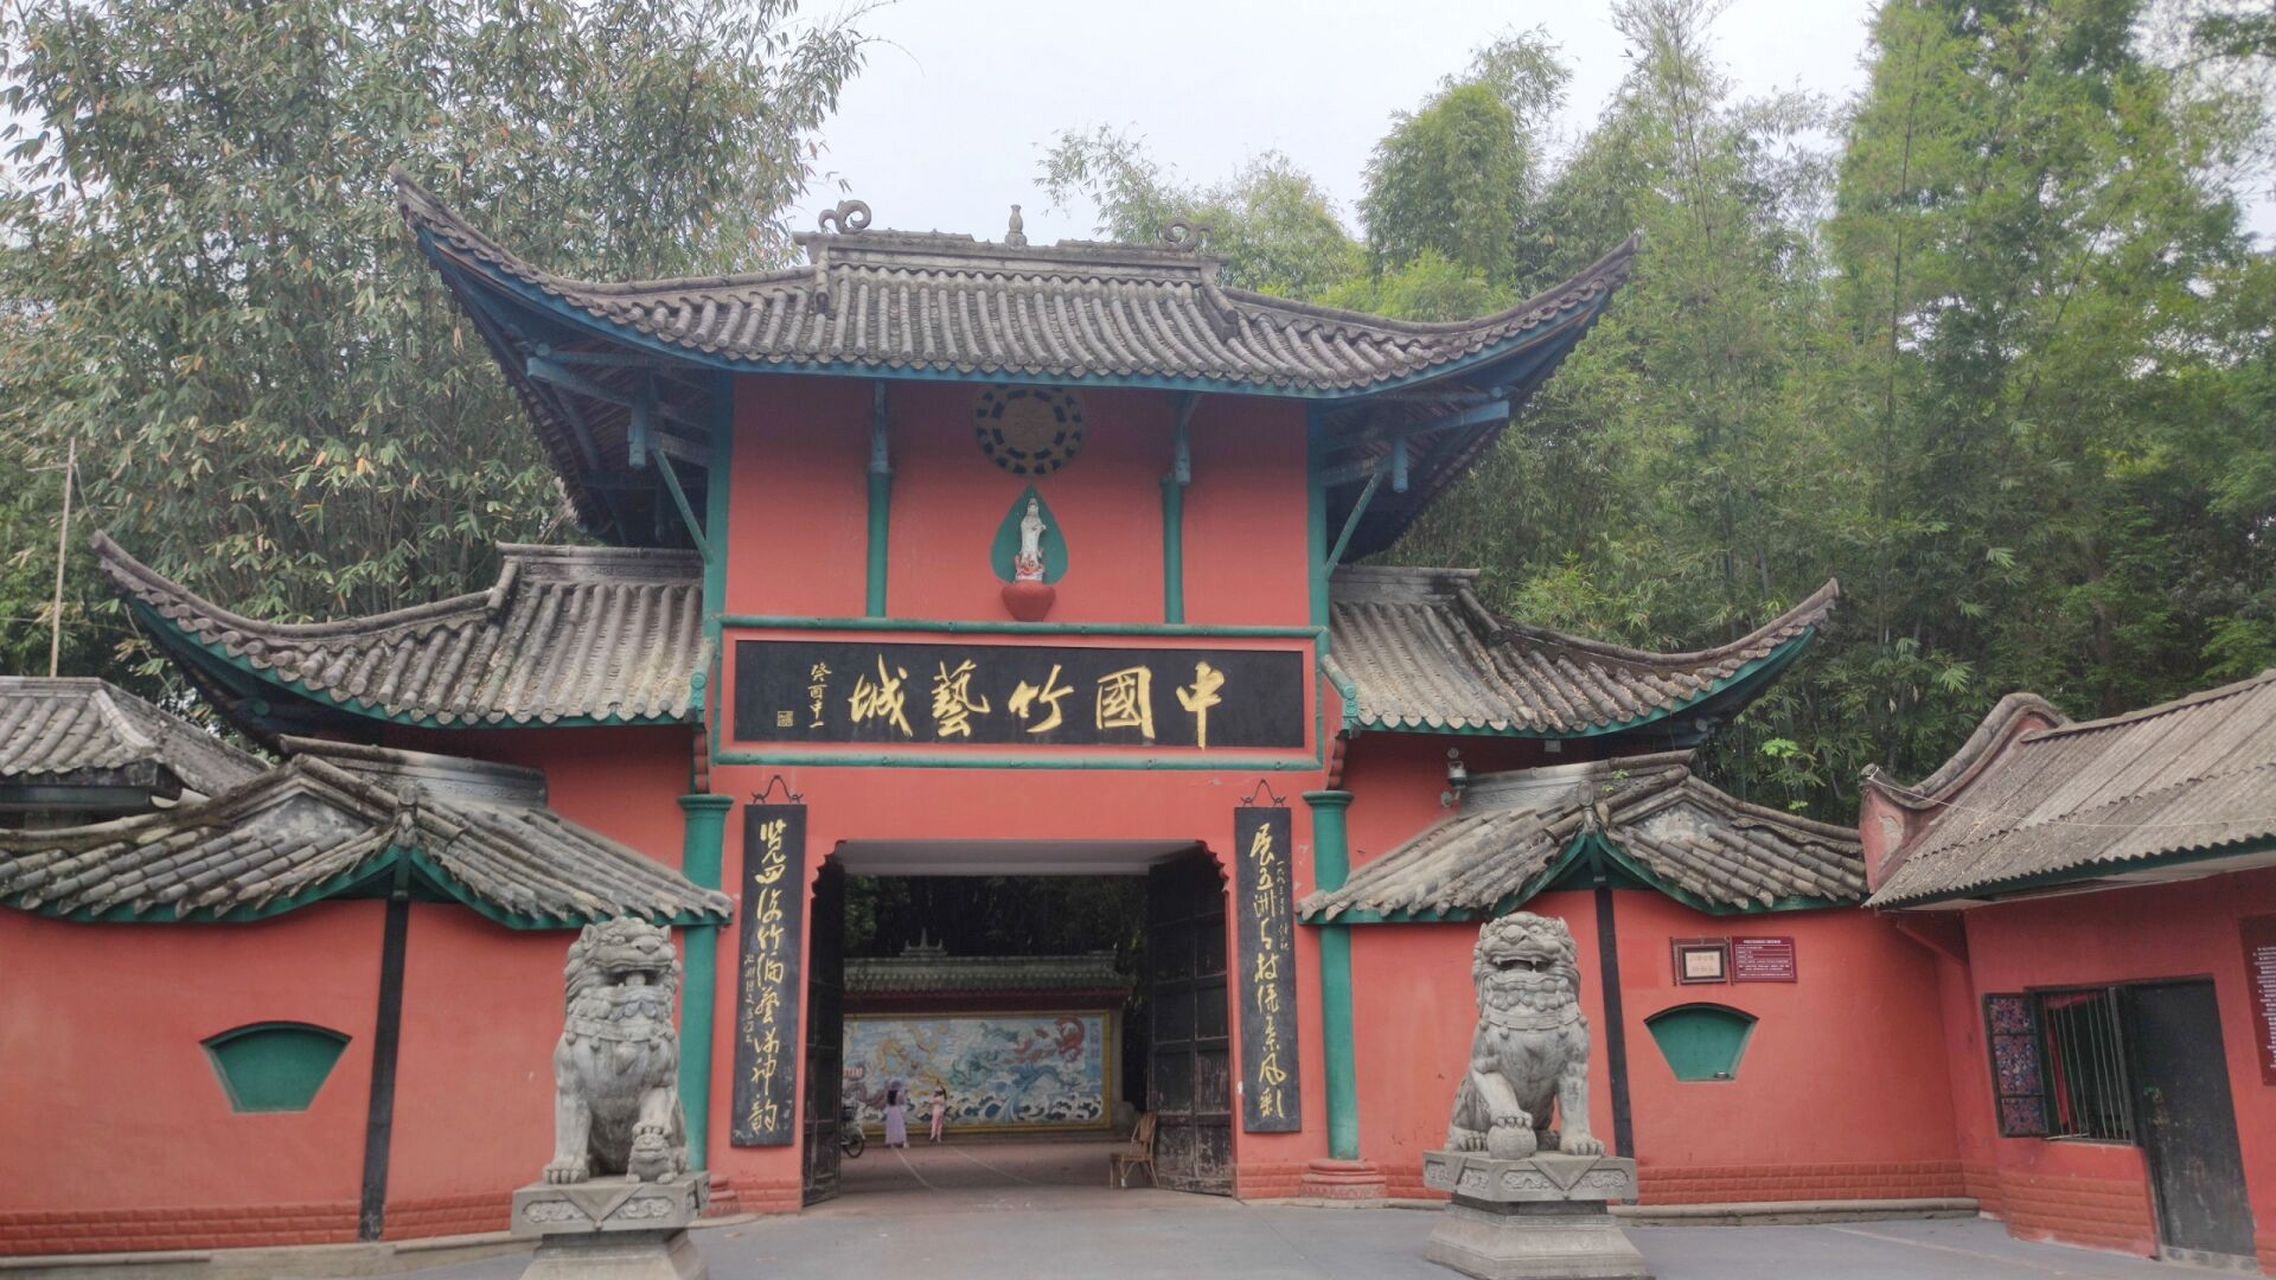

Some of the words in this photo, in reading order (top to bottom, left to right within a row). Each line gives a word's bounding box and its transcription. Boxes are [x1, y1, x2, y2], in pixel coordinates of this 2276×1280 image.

[849, 654, 1225, 752] 中國竹藝城
